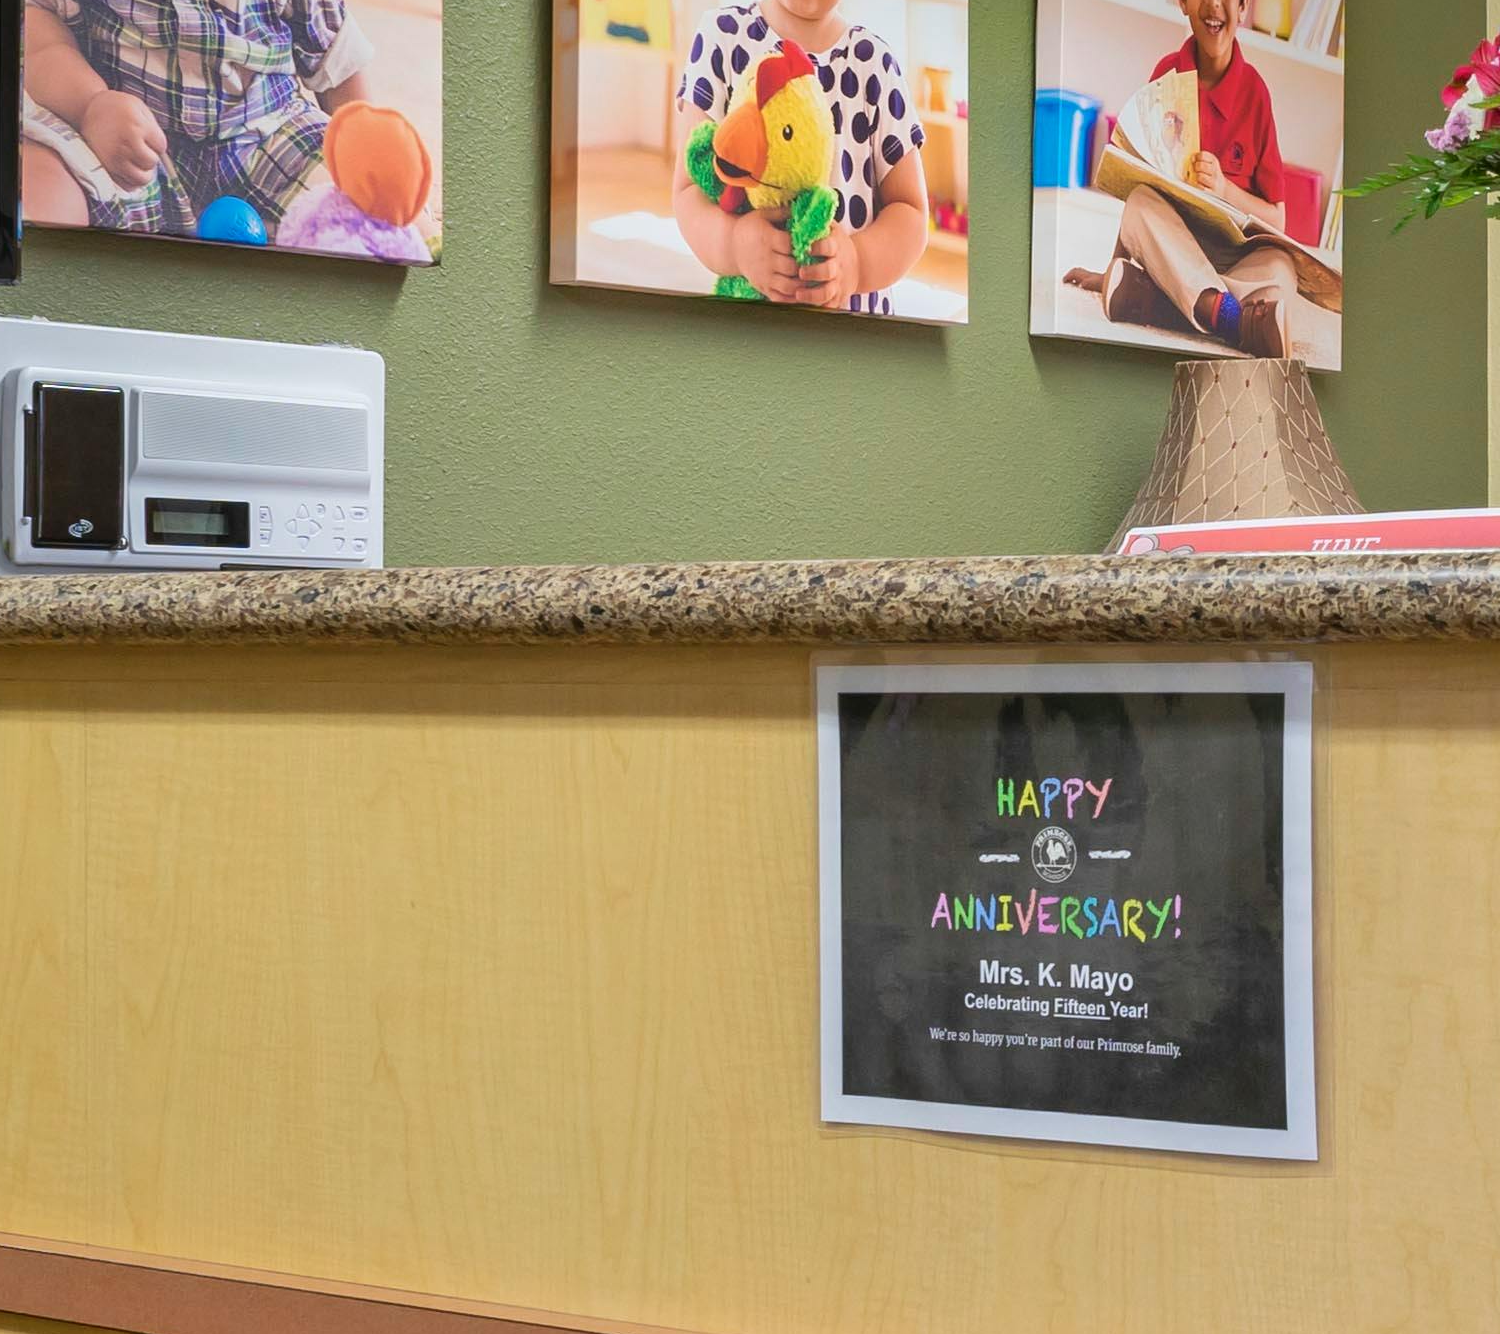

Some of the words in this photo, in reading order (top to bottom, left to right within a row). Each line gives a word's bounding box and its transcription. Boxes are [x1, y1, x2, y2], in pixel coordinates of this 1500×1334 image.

[996, 778, 1112, 820] HAPPY
[931, 887, 1184, 944] ANNIVERSARY!
[979, 959, 1030, 986] Mrs.
[1038, 962, 1062, 988] K.
[1070, 964, 1134, 997] Mayo
[964, 992, 1050, 1017] Celebrating
[1053, 997, 1107, 1018] Fifteen
[1109, 1000, 1149, 1019] Year!
[929, 1026, 957, 1041] We're
[958, 1031, 971, 1043] so
[972, 1029, 1004, 1048] happy
[1005, 1032, 1038, 1049] you're
[1040, 1035, 1062, 1051] part
[1063, 1035, 1076, 1050] of
[1076, 1038, 1096, 1051] our
[1097, 1038, 1145, 1055] Primrose
[1145, 1041, 1183, 1060] family.
